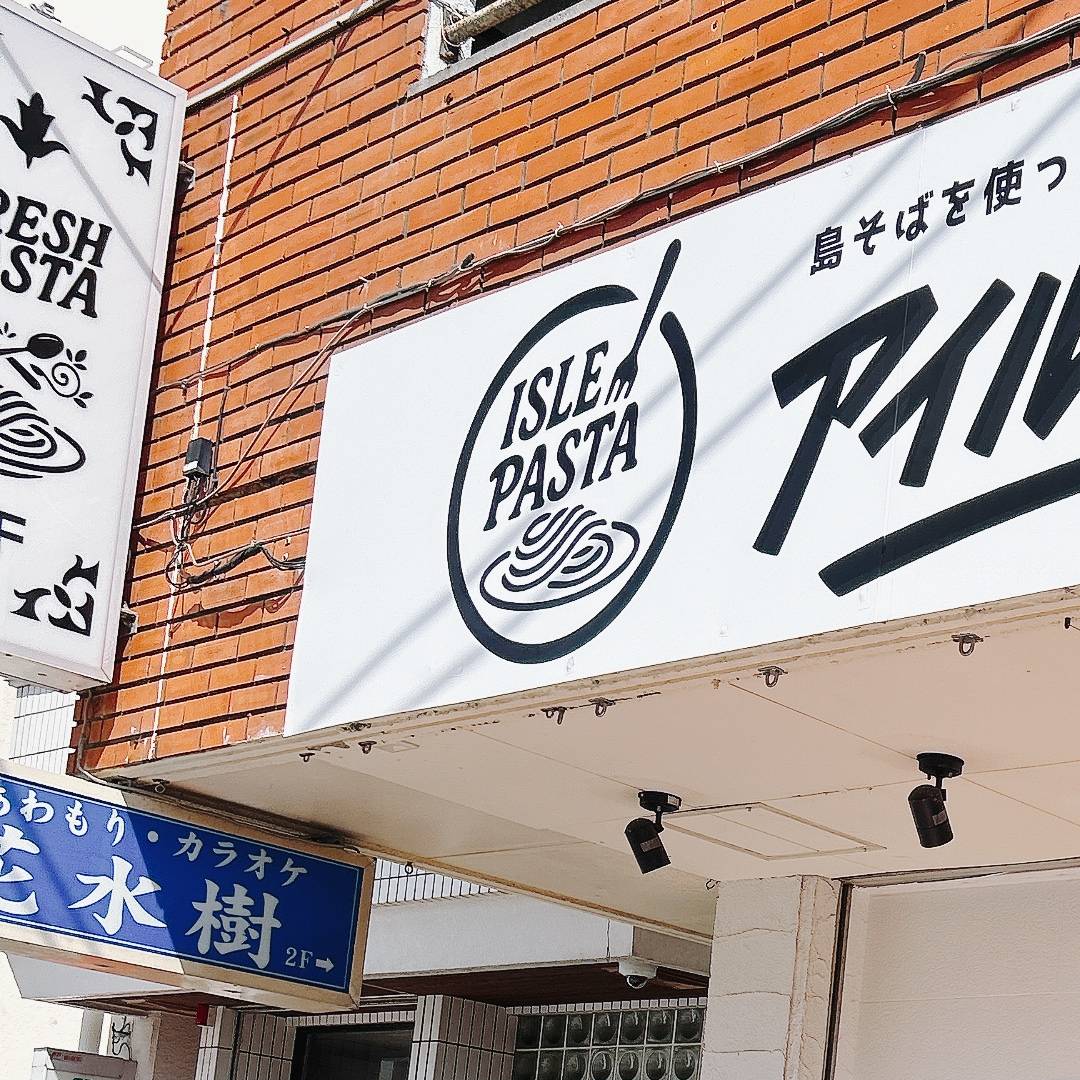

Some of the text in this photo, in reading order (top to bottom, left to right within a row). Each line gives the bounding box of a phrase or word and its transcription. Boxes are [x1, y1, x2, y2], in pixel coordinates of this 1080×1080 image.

[500, 340, 609, 449] ISLE
[483, 402, 638, 531] PASTA
[285, 947, 313, 969] 2F
